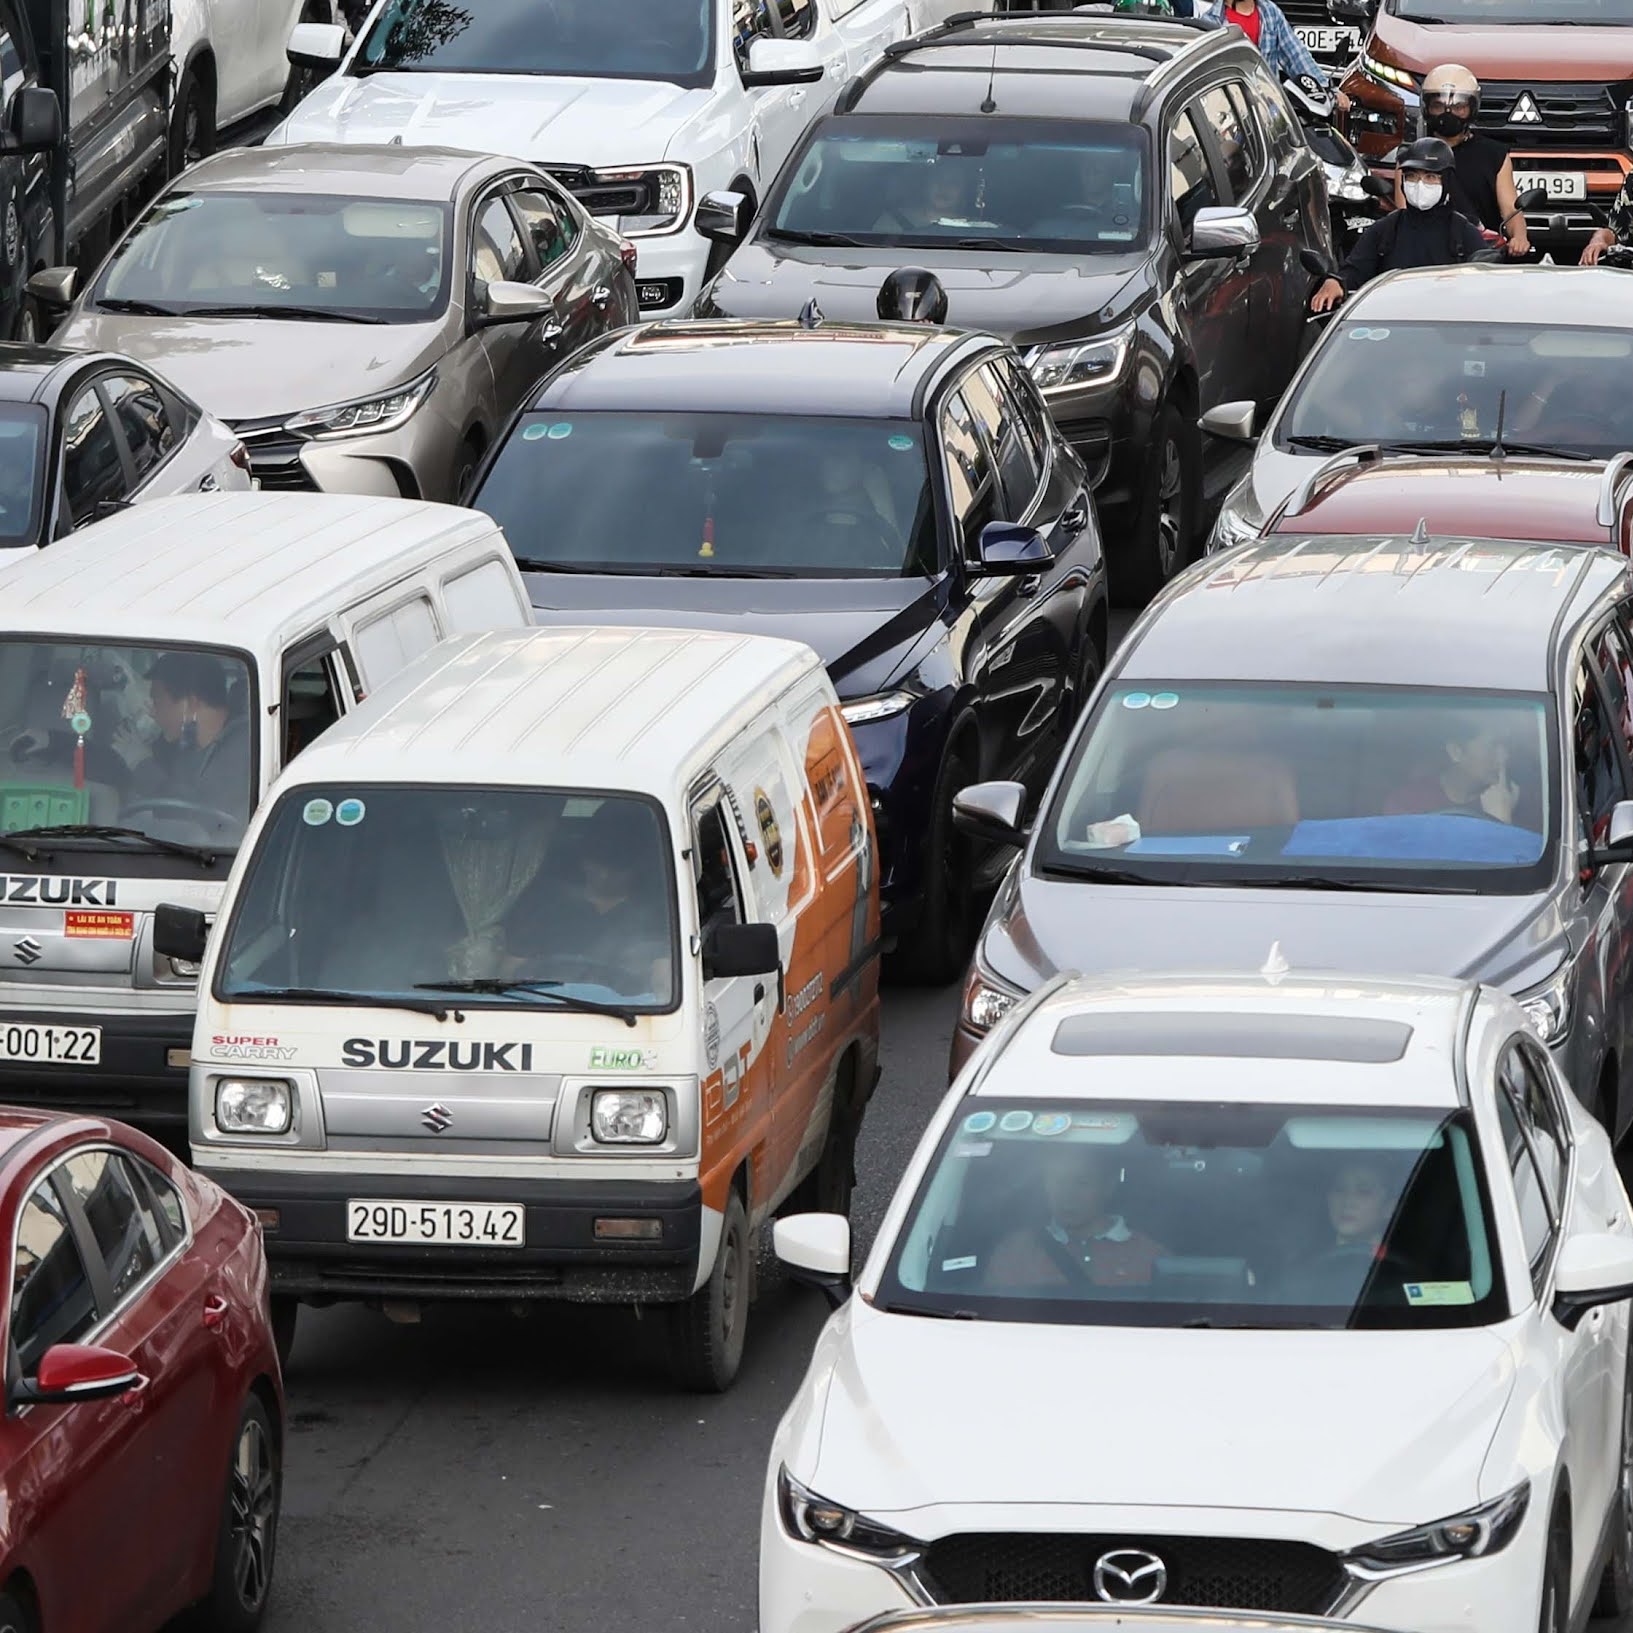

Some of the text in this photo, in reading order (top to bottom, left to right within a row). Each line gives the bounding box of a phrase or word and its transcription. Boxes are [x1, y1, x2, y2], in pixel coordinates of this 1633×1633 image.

[210, 1045, 298, 1061] CARRY
[212, 1035, 279, 1046] SUPER
[341, 1037, 533, 1073] SUZUKI
[353, 1205, 518, 1242] 29D-513.42
